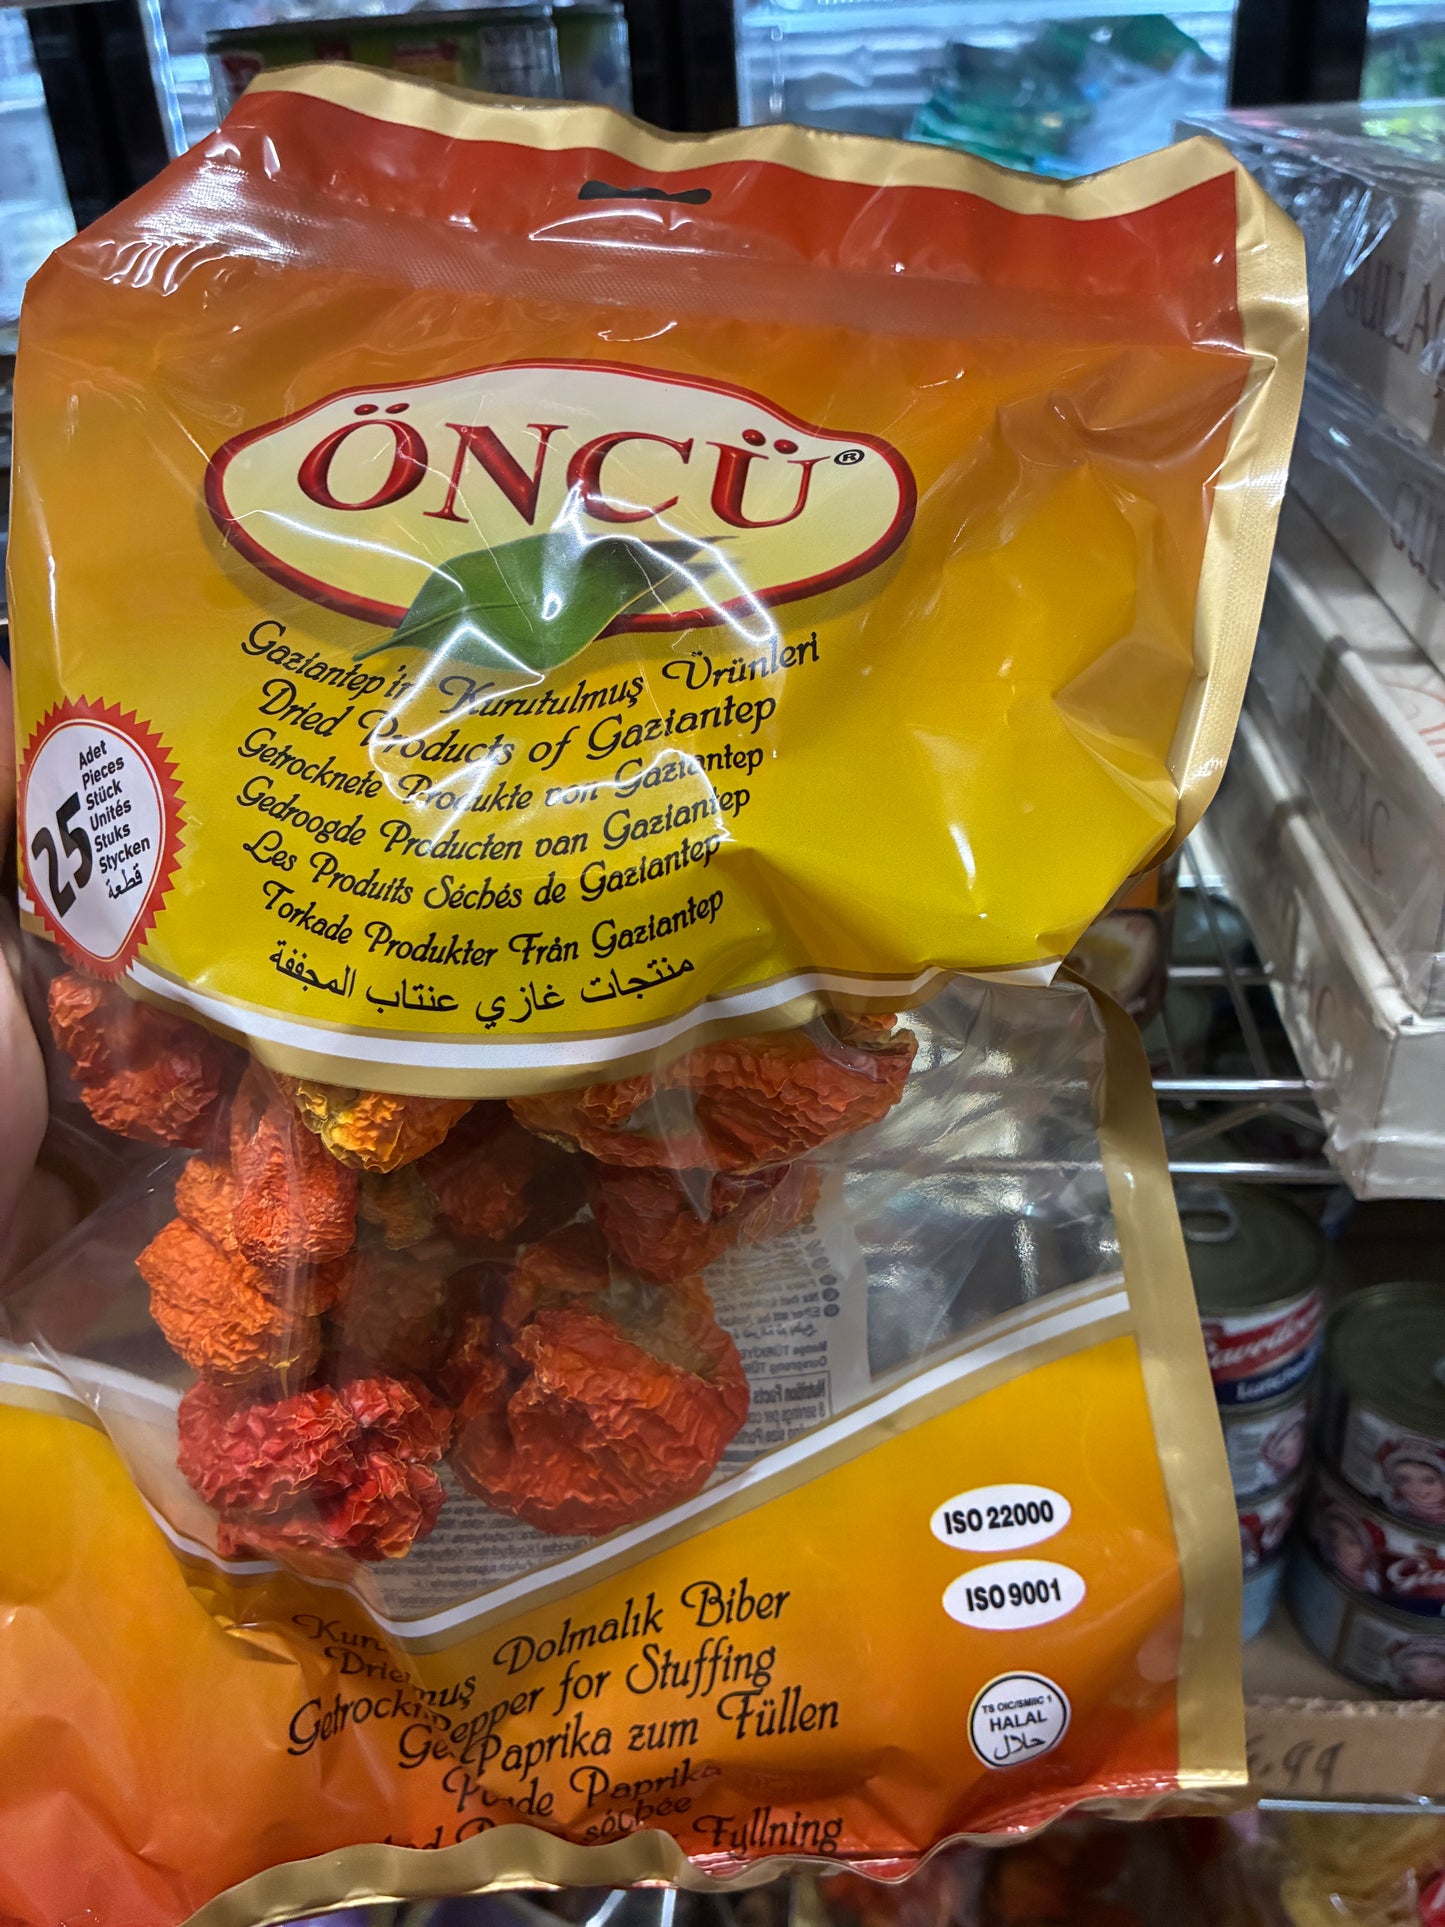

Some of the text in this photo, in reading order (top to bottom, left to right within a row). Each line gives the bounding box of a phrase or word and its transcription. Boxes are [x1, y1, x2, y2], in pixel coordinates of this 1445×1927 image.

[297, 402, 831, 529] ÖNCÜ
[439, 675, 645, 717] Kurutulmuş
[662, 631, 820, 690] Ürünleri
[258, 678, 776, 771] Dried Products of Gaziantep
[78, 740, 107, 770] Adet
[81, 756, 125, 790] Pieces
[237, 727, 764, 813] Getrocknete Produkte von Gaziantep
[86, 779, 123, 811] Stück
[89, 799, 132, 832] Unités
[236, 776, 751, 860] Gedroogde Producten van Gaziantep
[31, 791, 93, 918] 25
[95, 822, 131, 853] Stuks
[99, 836, 151, 874] Stycken
[106, 863, 143, 900] قطعة
[242, 830, 721, 910] Les Produits Séchés de Gaziantep
[262, 880, 724, 967] Torkade Produkter Från Gaziantep
[269, 940, 695, 1030] منتجات غازي عنتاب المجففة
[944, 1500, 1054, 1534] ISO 22000
[966, 1578, 1061, 1612] ISO 9001
[493, 1592, 664, 1675] Dolmalık
[681, 1577, 790, 1627] Biber
[553, 1660, 611, 1716] for
[626, 1635, 776, 1699] Stuffing
[982, 1704, 995, 1714] TS
[1047, 1694, 1052, 1703] 1
[989, 1710, 1047, 1732] HALAL
[460, 1711, 611, 1781] Paprika
[627, 1717, 699, 1752] zum
[716, 1685, 840, 1740] Füllen
[994, 1732, 1045, 1760] حلال
[570, 1758, 722, 1809] Paprika
[692, 1804, 844, 1858] Fyllning
